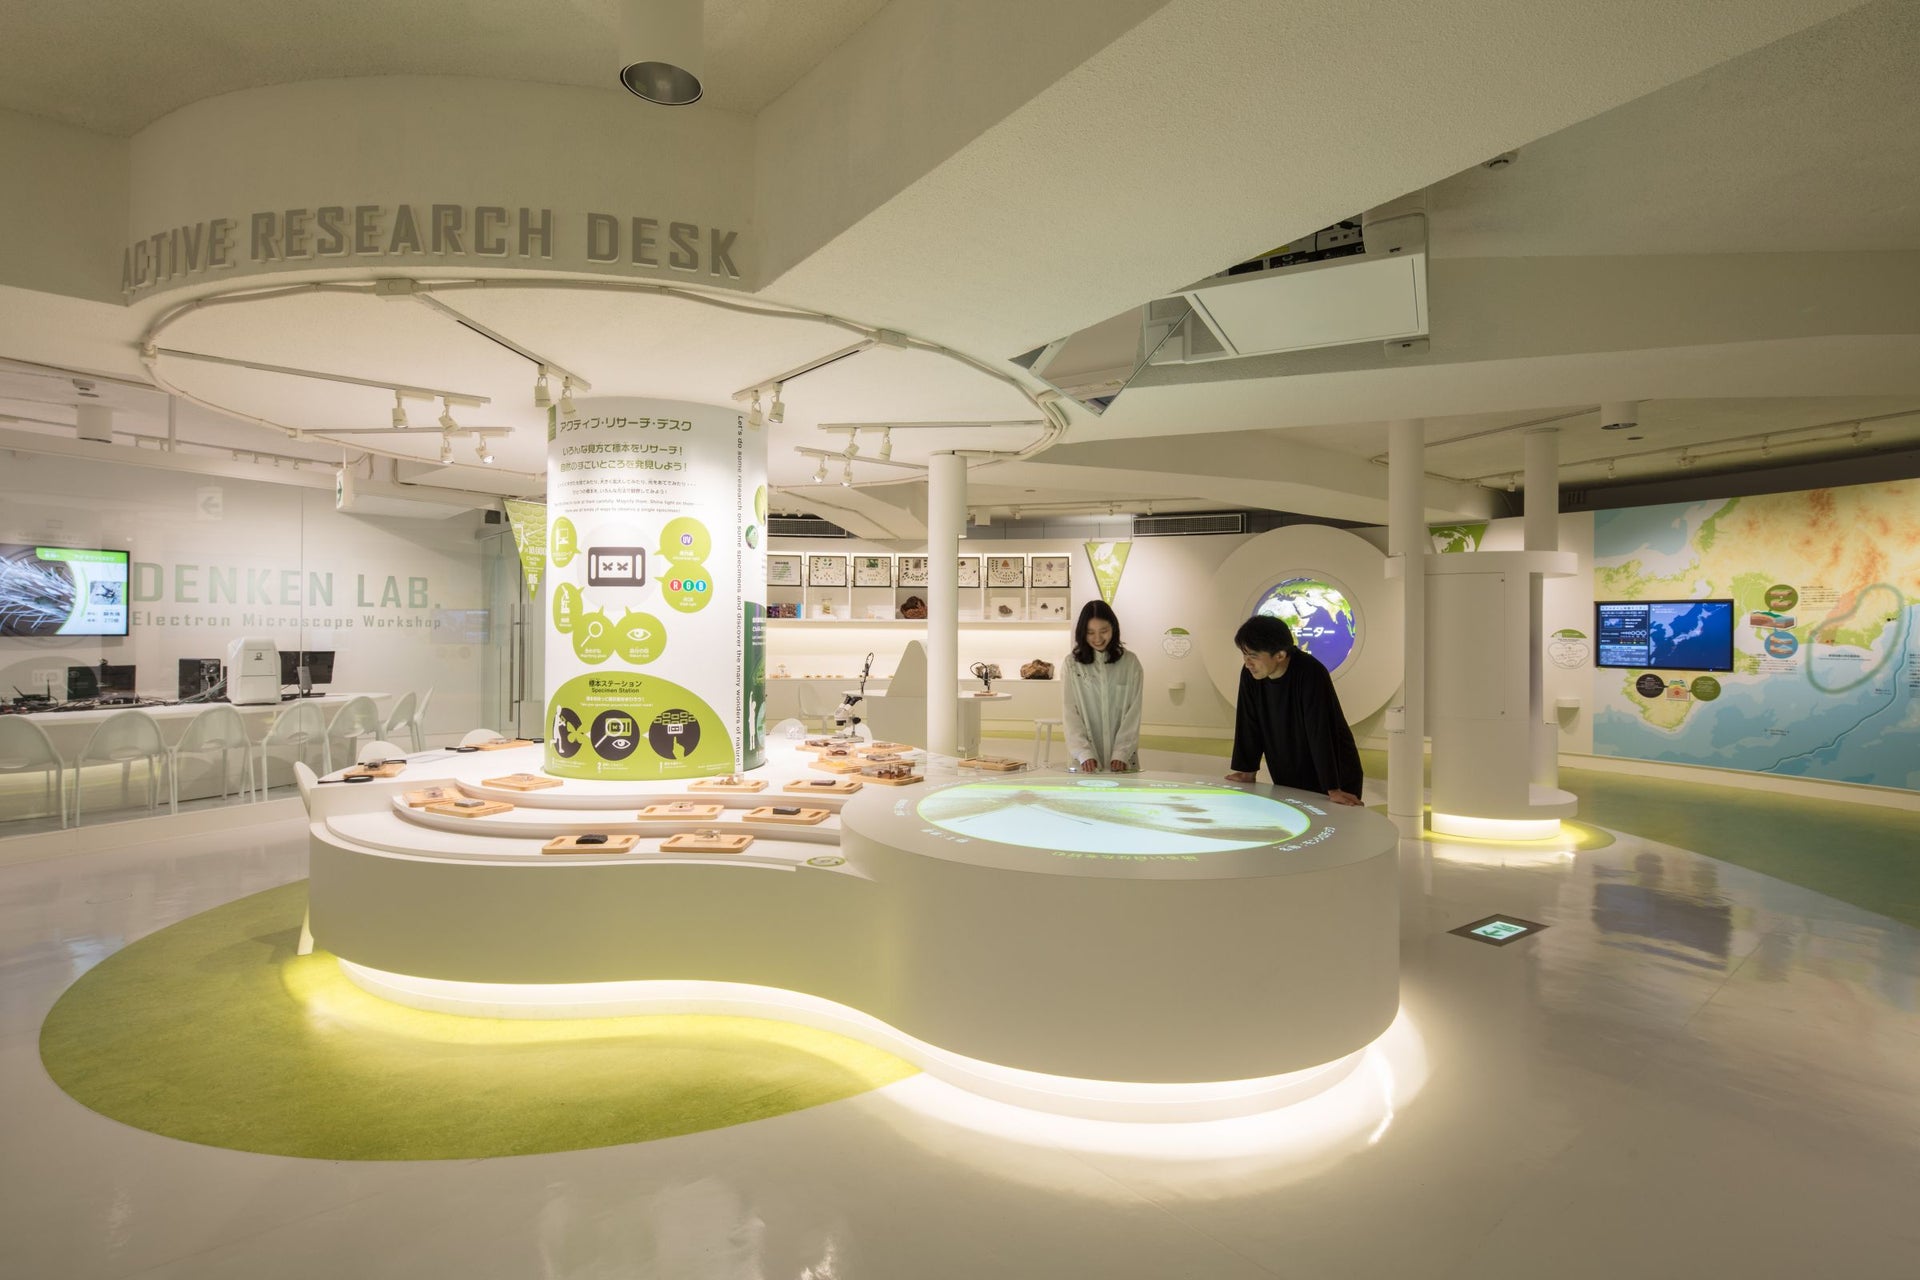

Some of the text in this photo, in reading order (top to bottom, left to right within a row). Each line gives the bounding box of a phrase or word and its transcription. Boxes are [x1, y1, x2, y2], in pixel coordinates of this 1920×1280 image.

[122, 203, 740, 294] ACTIVE RESEARCH DESK
[560, 416, 692, 433] アクティブ・リサーチ・デスク
[737, 438, 744, 449] do
[737, 513, 742, 523] on
[682, 535, 691, 544] UV
[133, 561, 441, 609] DENKEN LAB.
[132, 611, 441, 630] Electron Microscope Workshop
[736, 726, 742, 734] of
